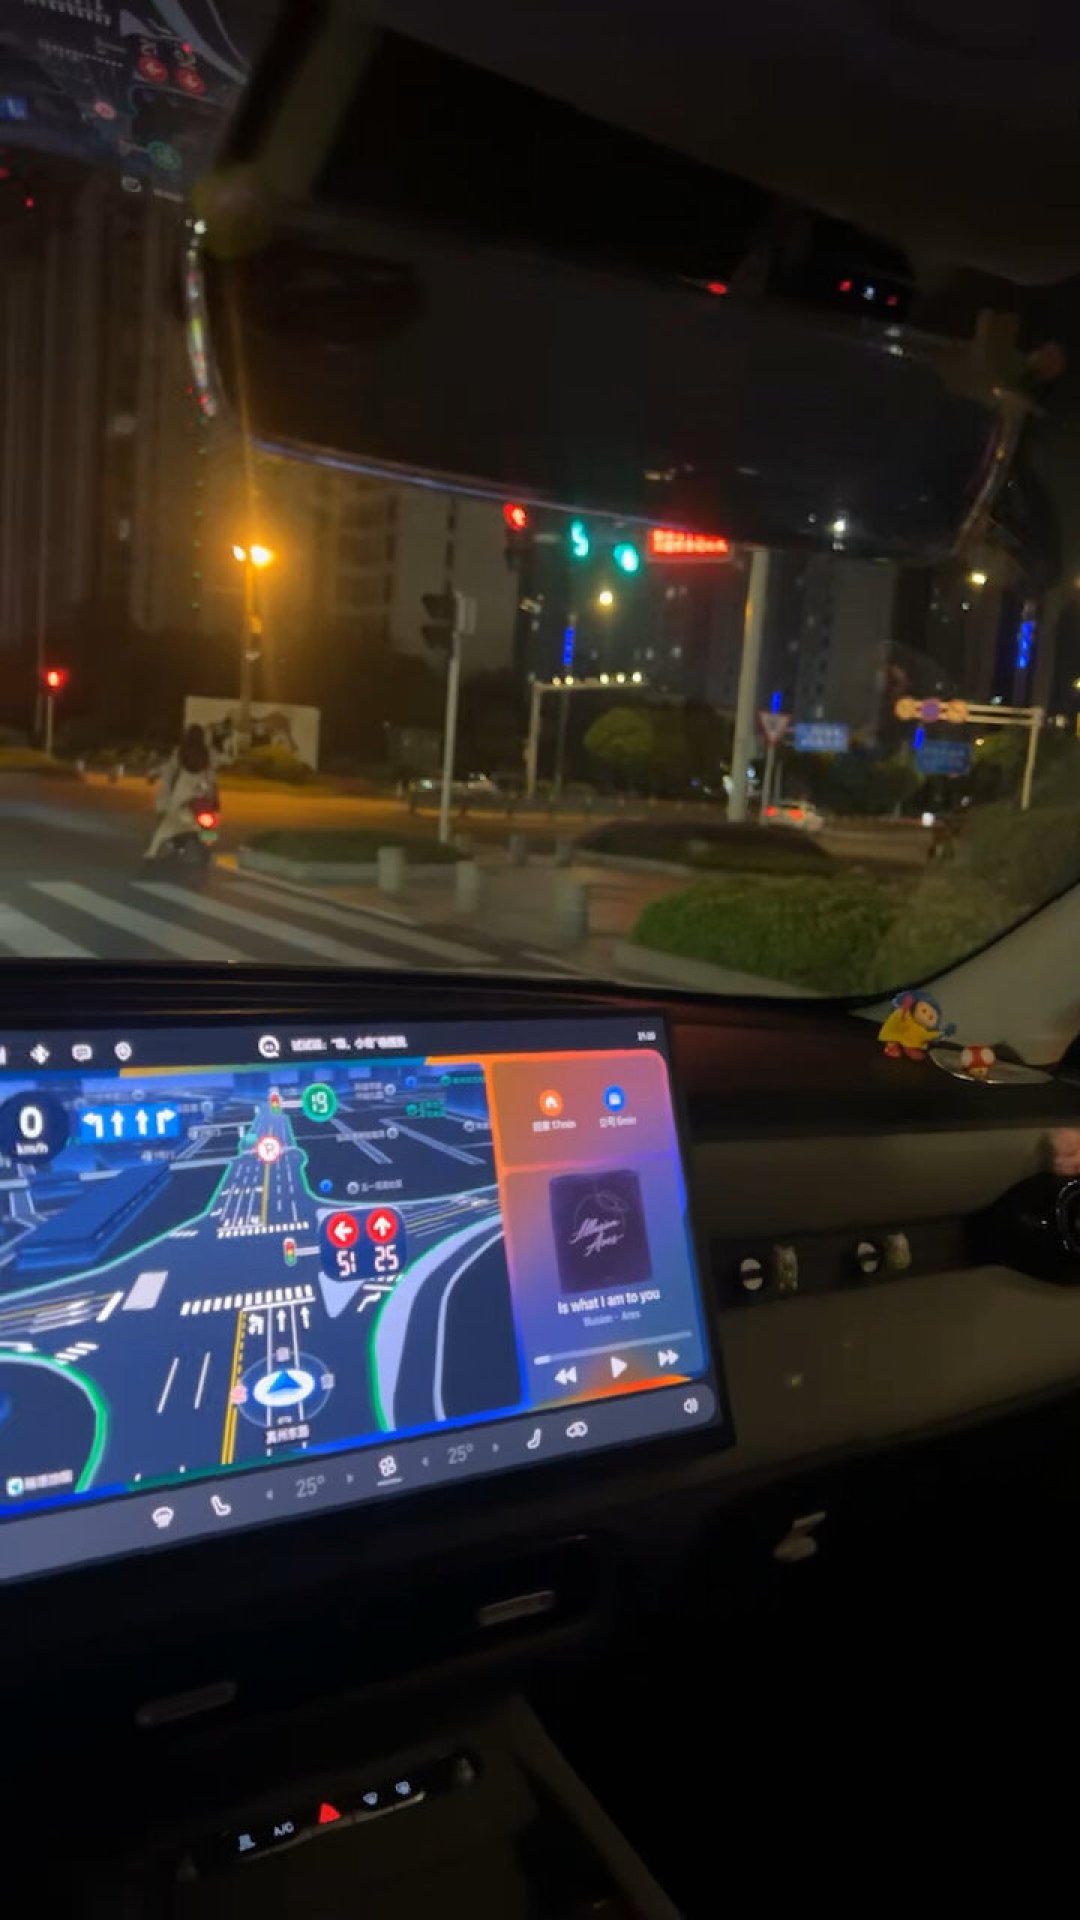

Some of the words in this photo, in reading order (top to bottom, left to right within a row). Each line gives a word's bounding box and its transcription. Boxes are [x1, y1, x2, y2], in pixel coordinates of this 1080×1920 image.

[311, 1091, 328, 1113] 19
[19, 1106, 43, 1139] 0
[337, 1249, 357, 1277] 51
[374, 1244, 400, 1273] 25
[558, 1301, 569, 1314] Is
[570, 1298, 599, 1312] what
[606, 1295, 625, 1307] am
[626, 1292, 638, 1304] to
[639, 1290, 661, 1304] you
[273, 1822, 295, 1837] A/C
